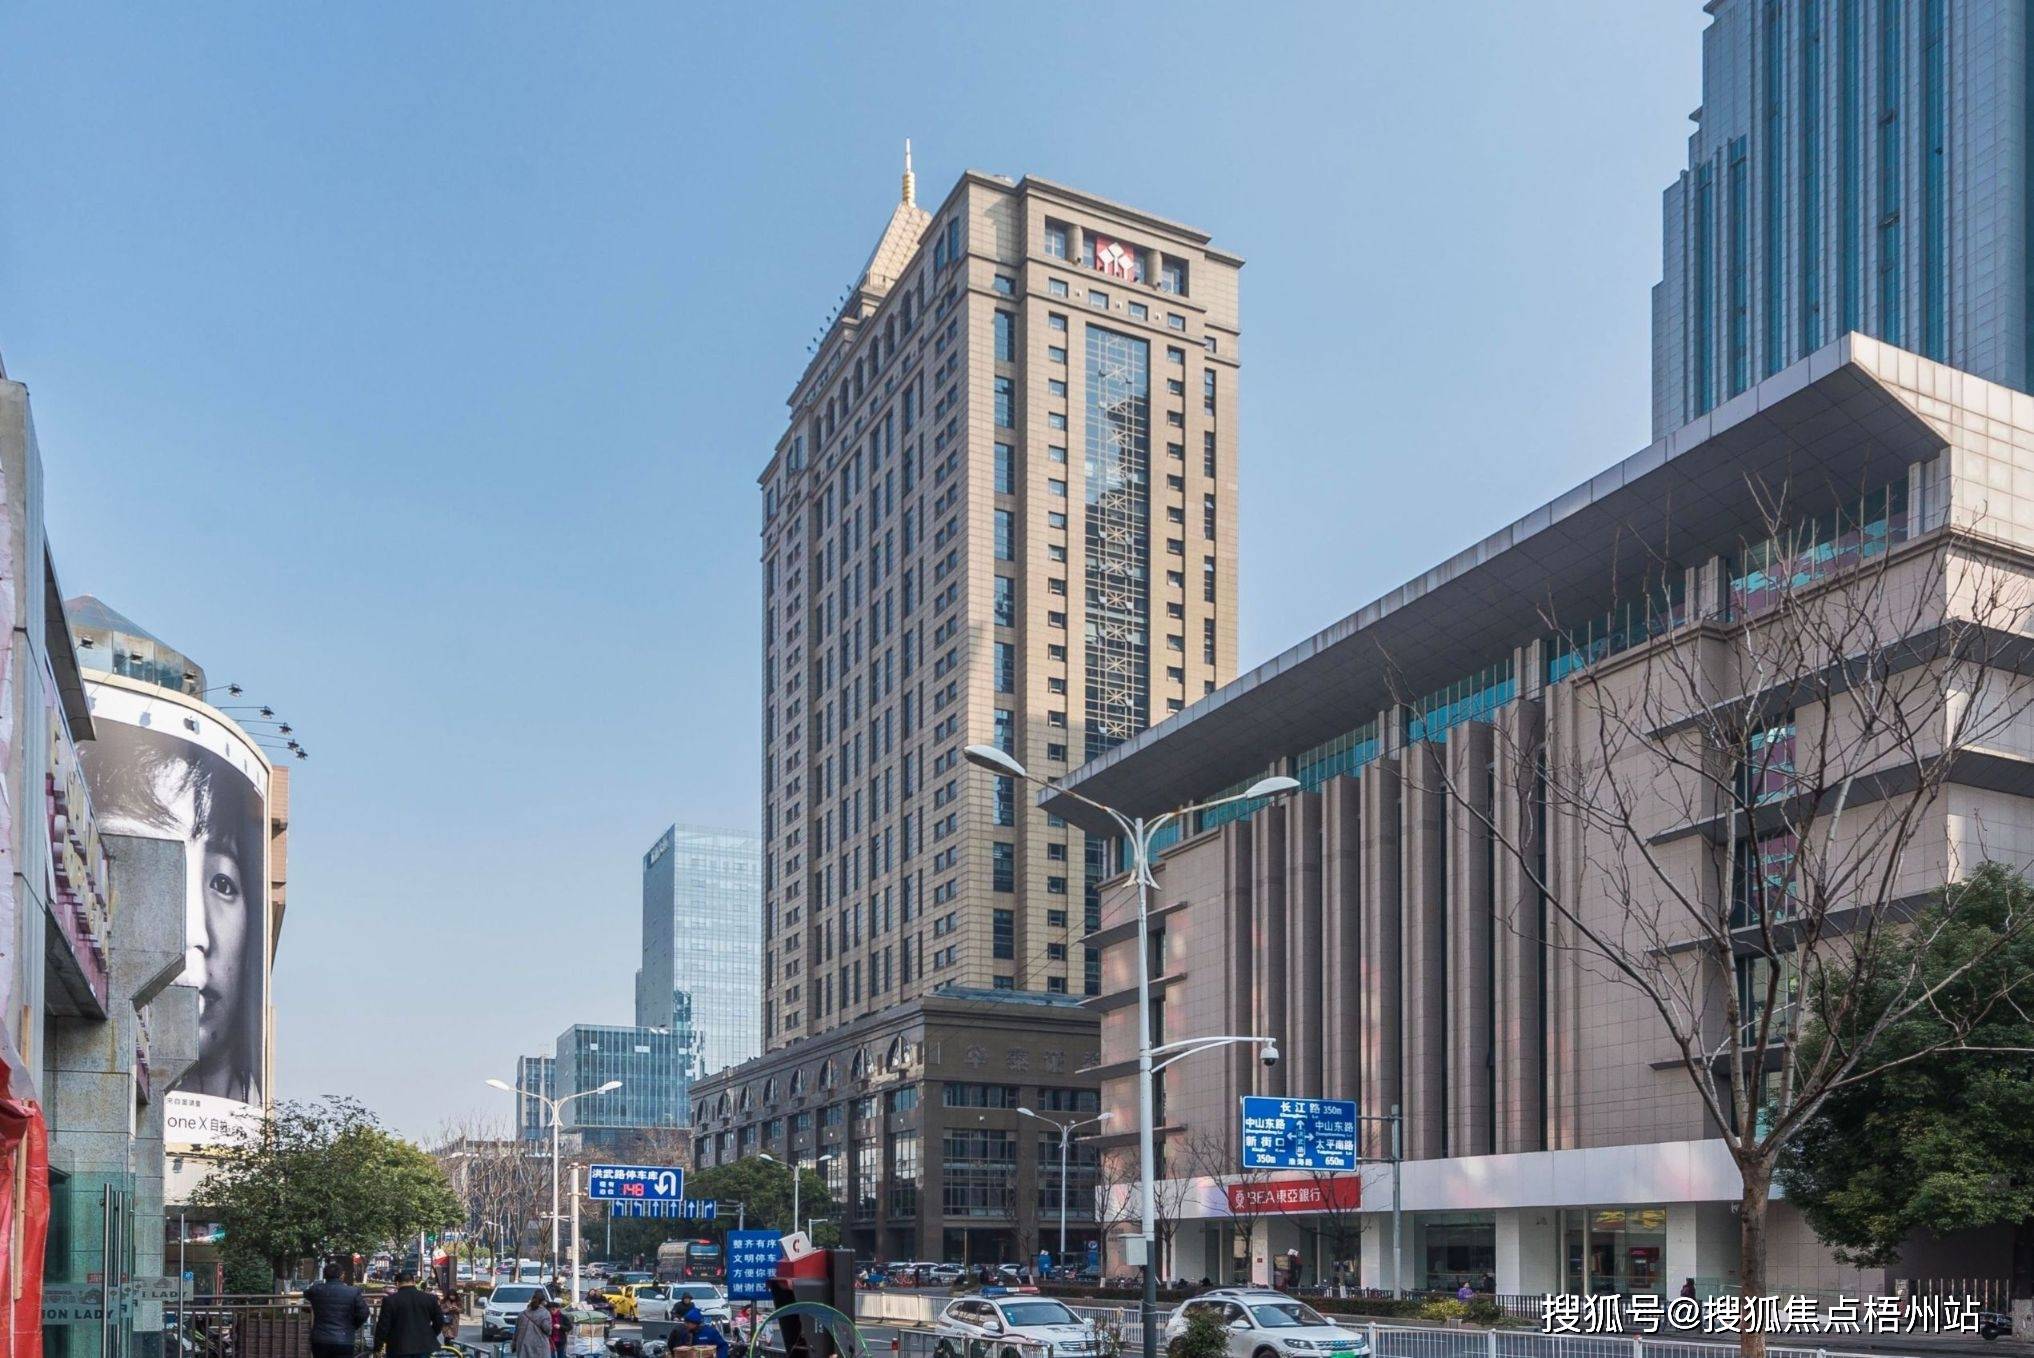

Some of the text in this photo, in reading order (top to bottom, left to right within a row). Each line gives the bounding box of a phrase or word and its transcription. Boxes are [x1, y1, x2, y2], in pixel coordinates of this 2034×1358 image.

[1280, 1101, 1342, 1115] 长江路 350m
[1245, 1117, 1285, 1130] 中山东路
[1315, 1121, 1353, 1132] 中山东路
[1246, 1136, 1285, 1148] 新街口
[1316, 1139, 1353, 1151] 太平南路
[1256, 1154, 1276, 1164] 350m
[1325, 1156, 1344, 1166] 650m
[592, 1169, 658, 1180] 洪武路停车库
[623, 1183, 644, 1196] 148
[1276, 1188, 1320, 1203] 東亞銀行
[733, 1239, 777, 1249] 整齐有序
[733, 1254, 777, 1263] 文明停车
[733, 1269, 777, 1278] 方便你我
[733, 1283, 771, 1292] 谢谢配
